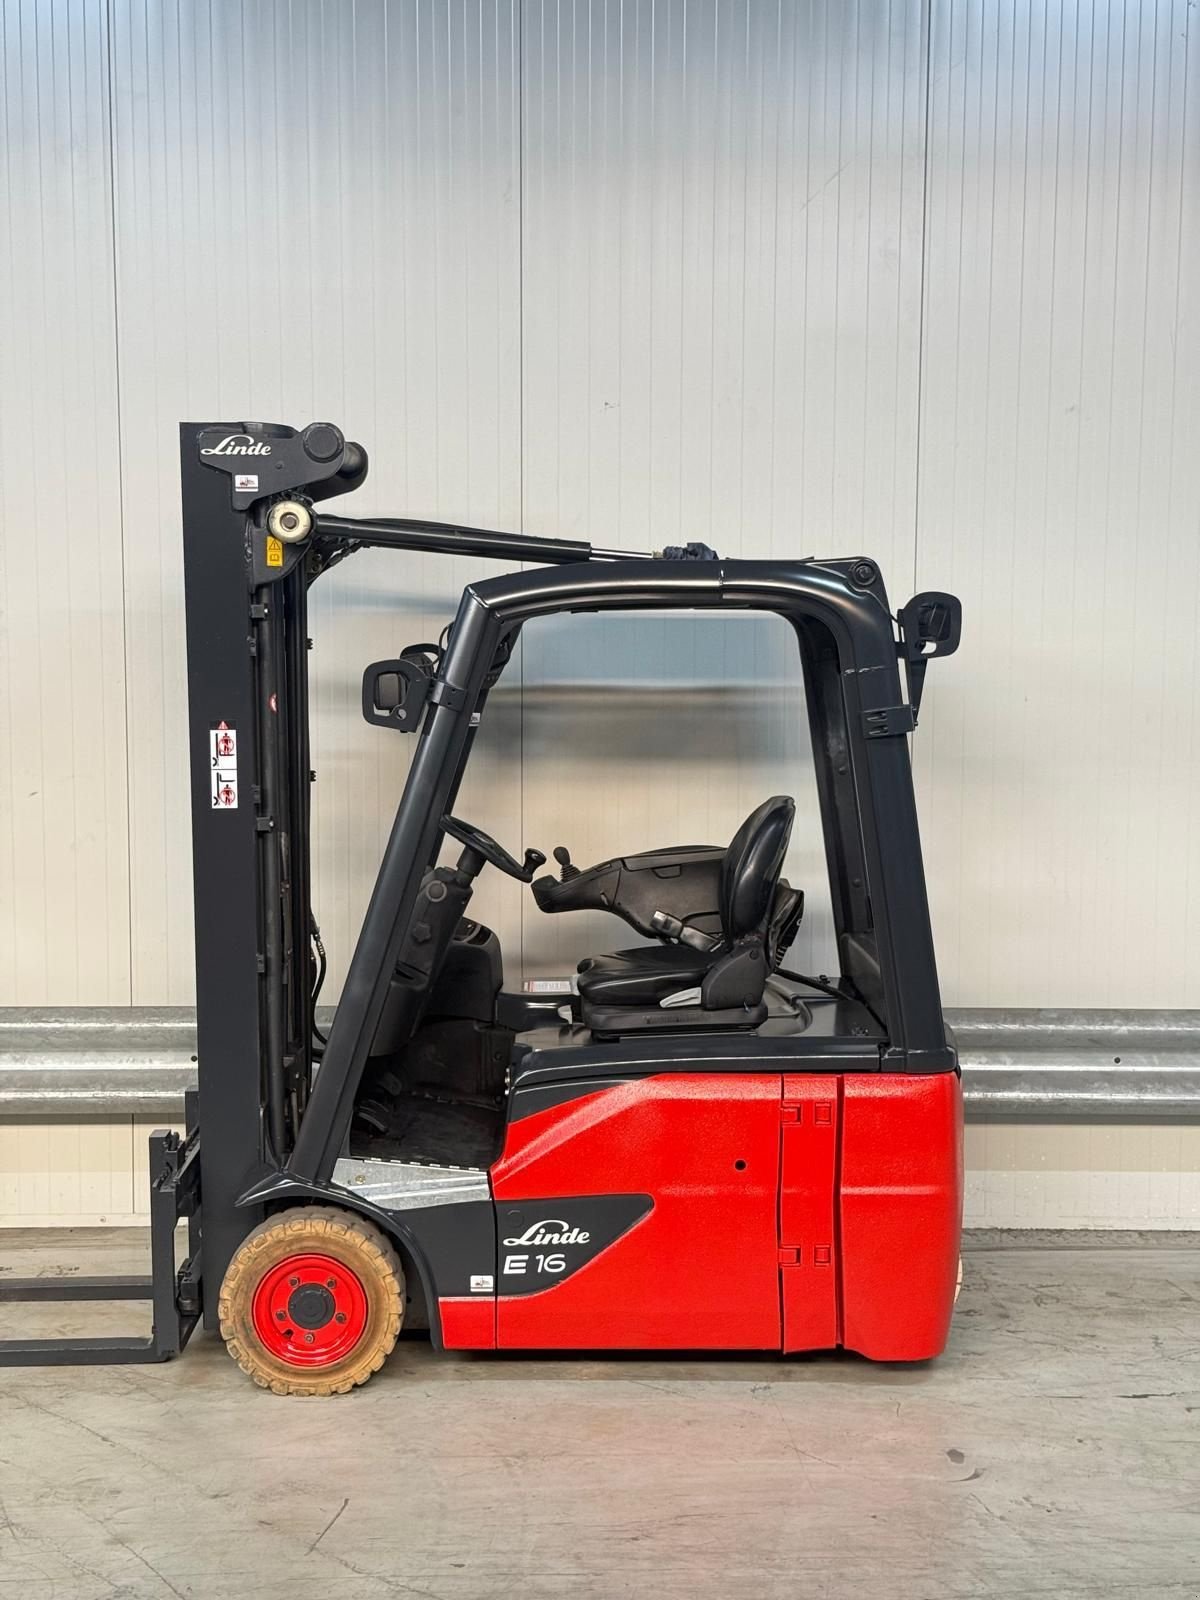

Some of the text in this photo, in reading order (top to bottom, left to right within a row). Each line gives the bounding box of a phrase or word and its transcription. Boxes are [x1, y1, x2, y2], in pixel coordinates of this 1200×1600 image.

[201, 434, 272, 456] Linde
[503, 1219, 591, 1247] Linde
[503, 1253, 567, 1275] E 16
